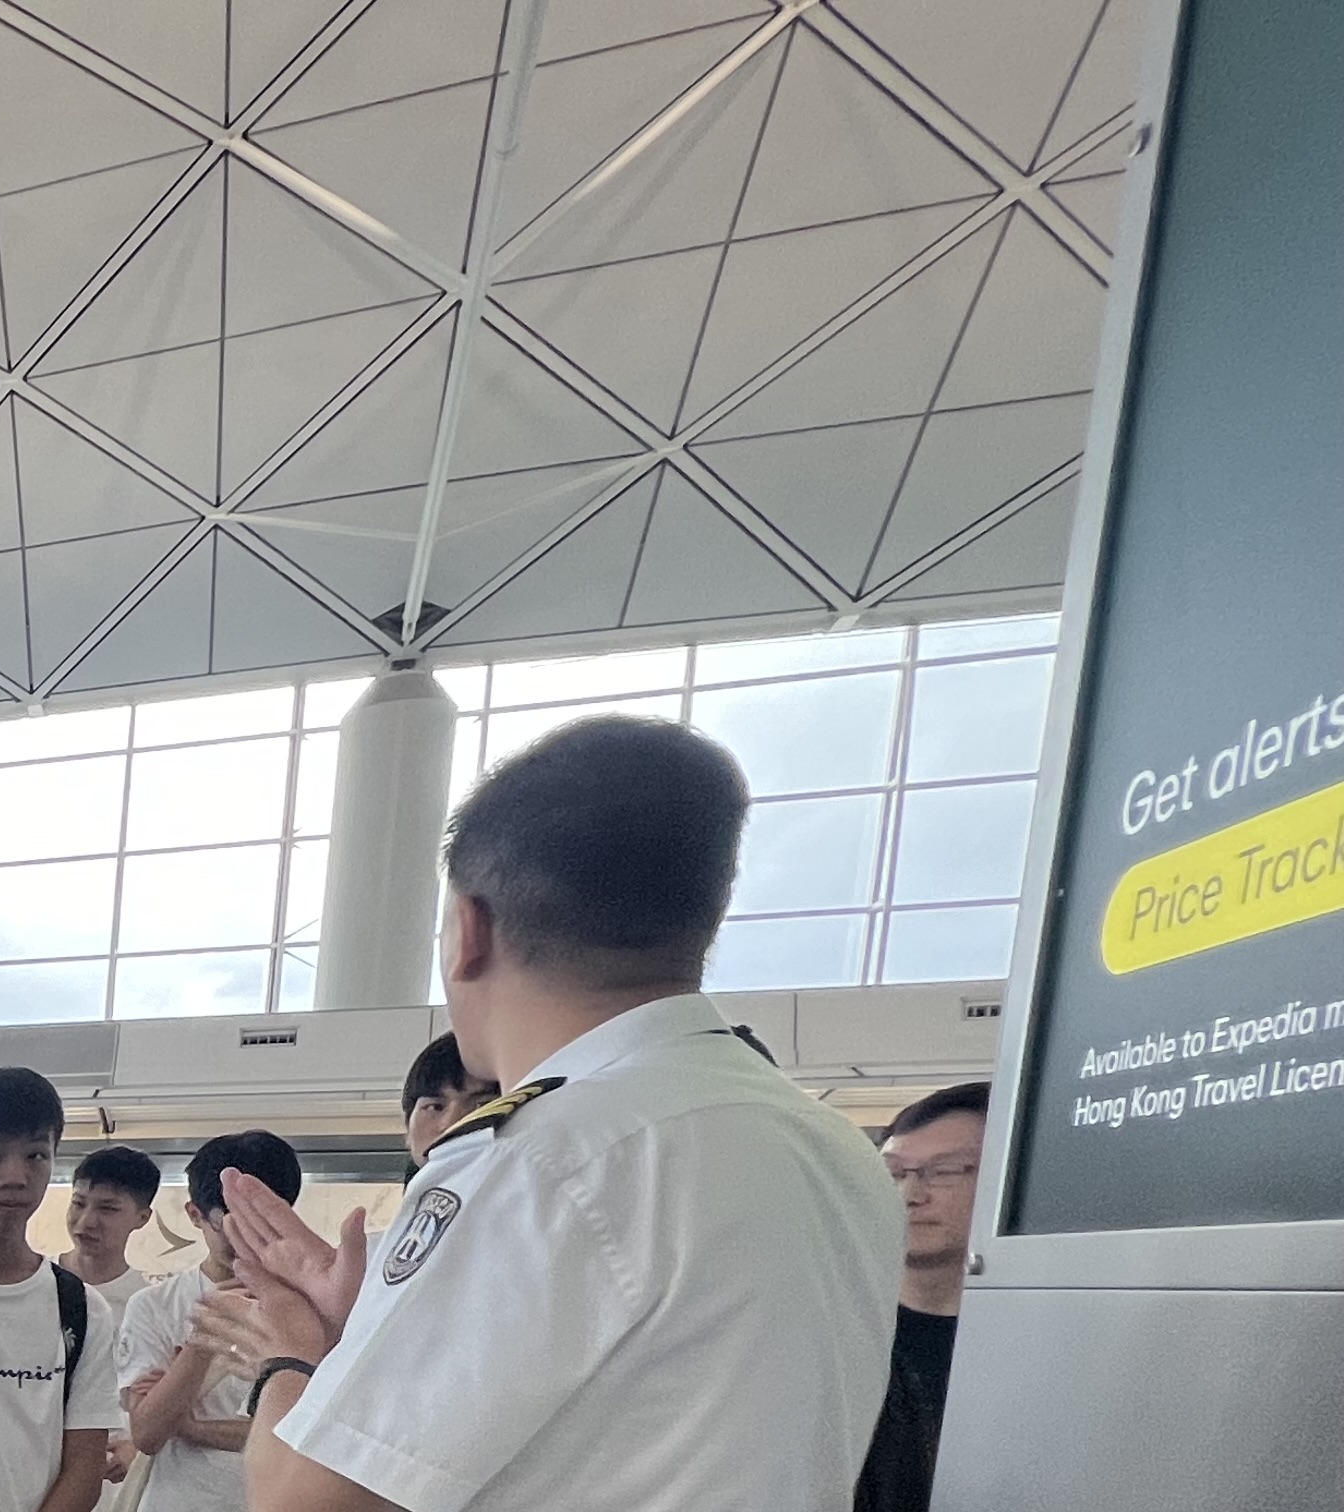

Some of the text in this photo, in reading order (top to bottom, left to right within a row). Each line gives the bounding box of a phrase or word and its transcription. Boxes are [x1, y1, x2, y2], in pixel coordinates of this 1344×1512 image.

[1122, 693, 1344, 835] Get alerts
[1129, 874, 1223, 941] Price
[1078, 1031, 1177, 1079] Available
[1182, 1029, 1205, 1059] to
[1209, 1000, 1318, 1054] Expedia
[1072, 1095, 1127, 1128] Hong
[1130, 1085, 1186, 1119] Kong
[1189, 1062, 1266, 1109] Travel
